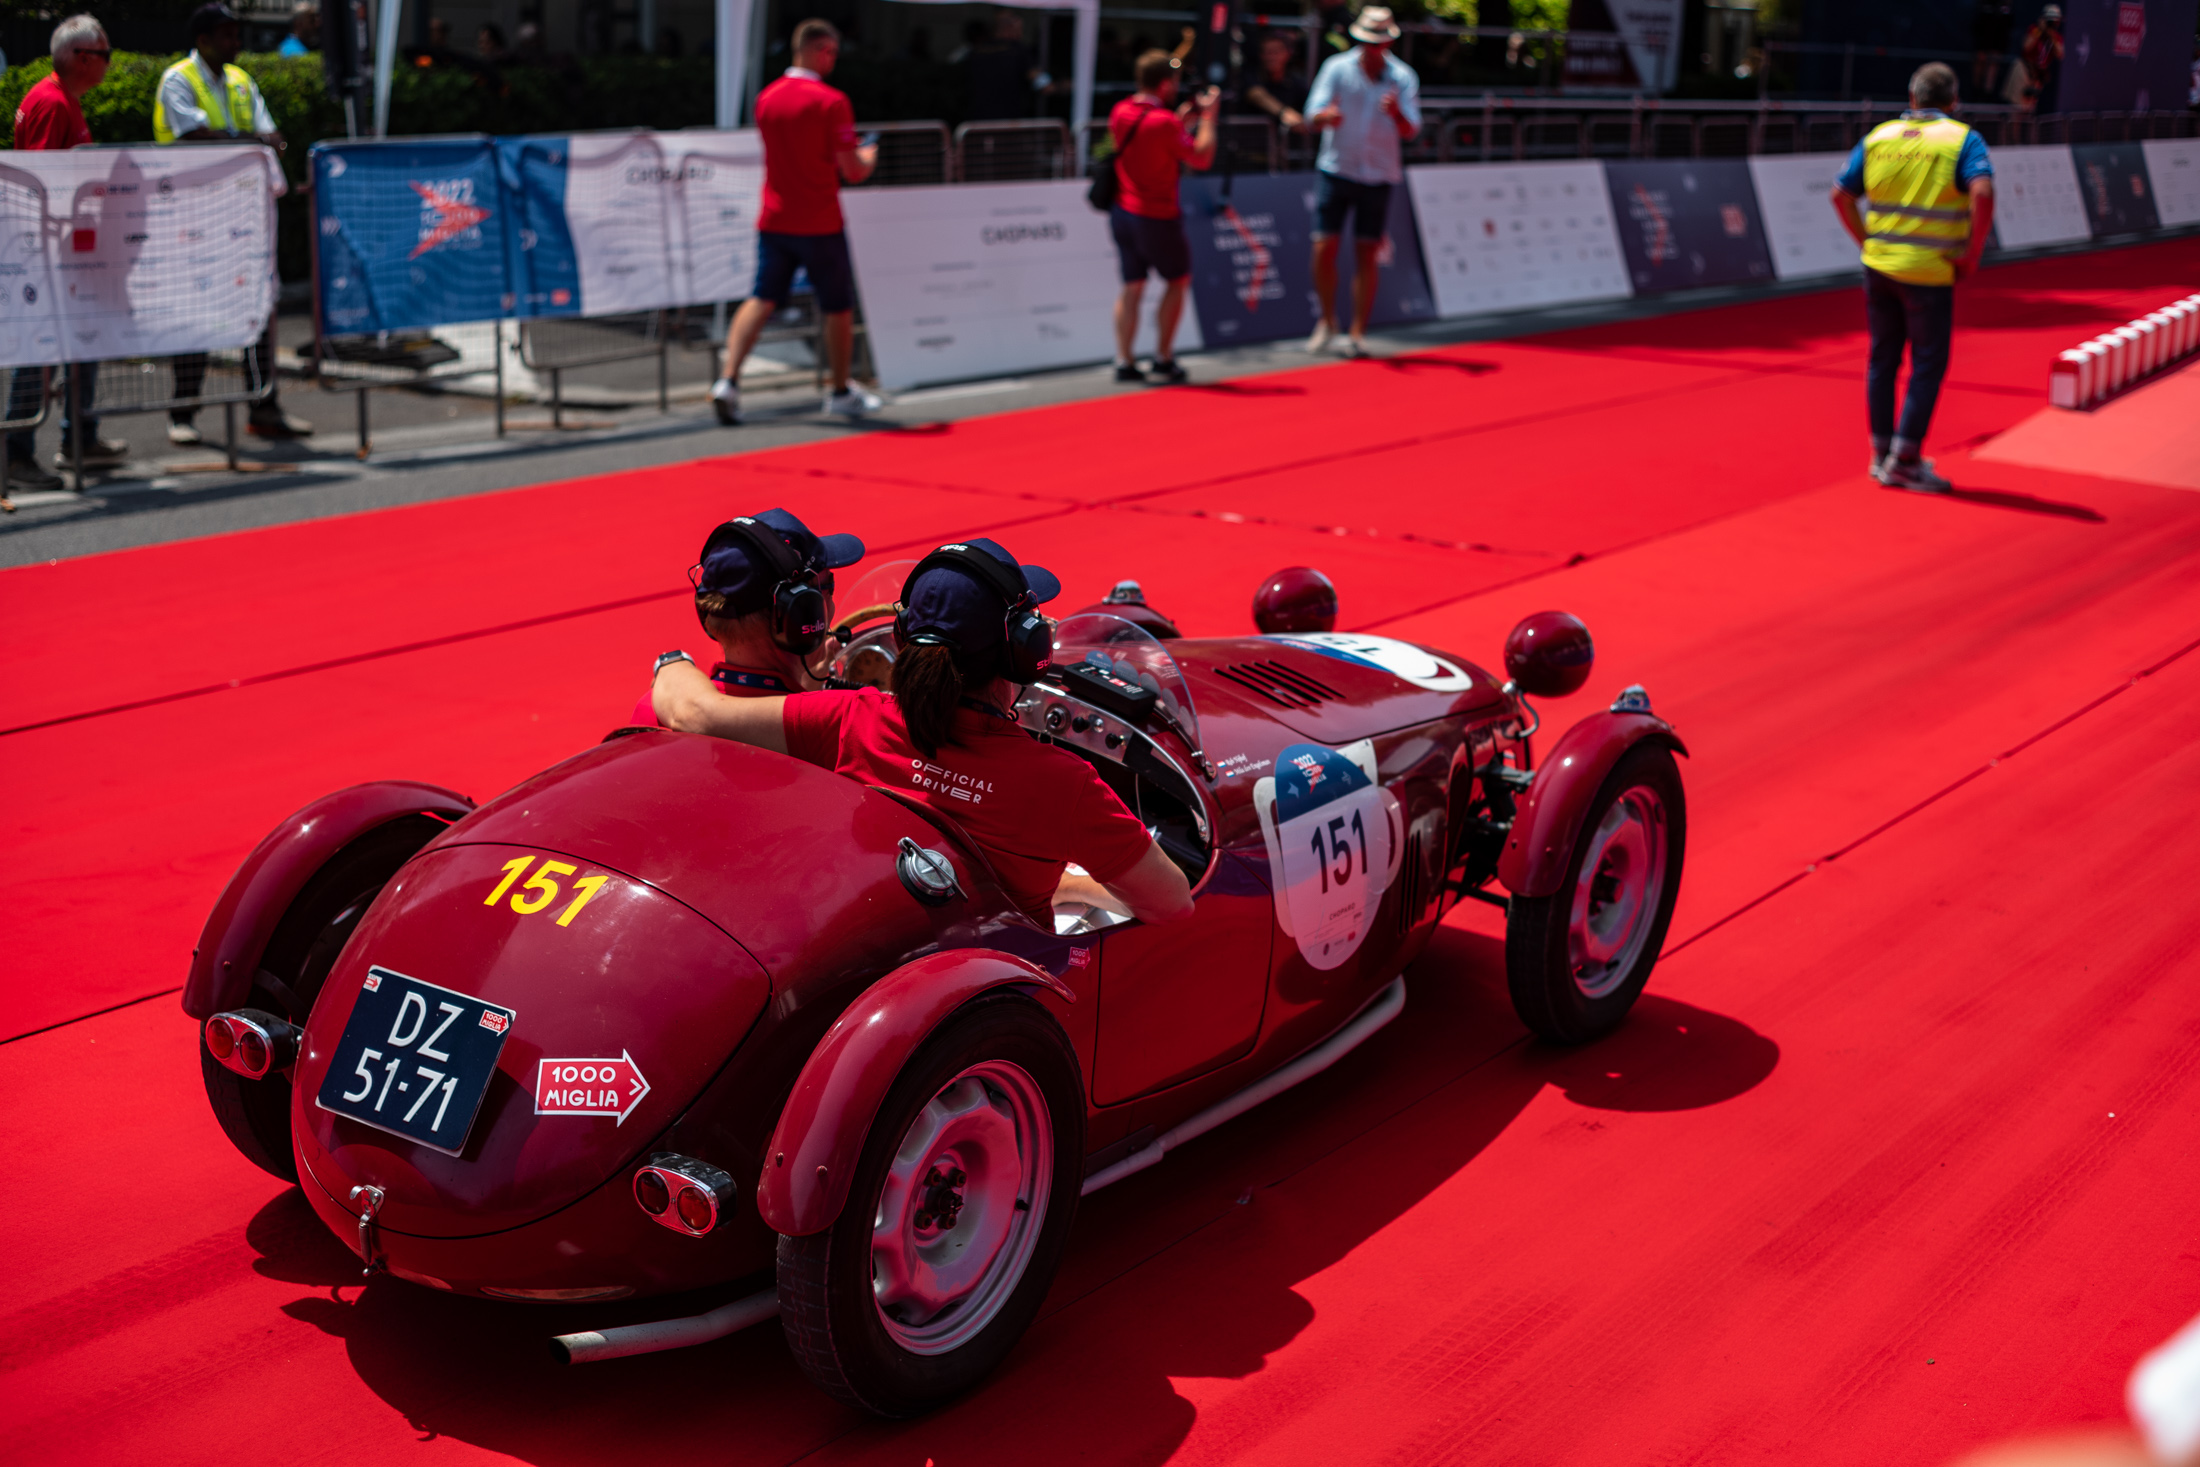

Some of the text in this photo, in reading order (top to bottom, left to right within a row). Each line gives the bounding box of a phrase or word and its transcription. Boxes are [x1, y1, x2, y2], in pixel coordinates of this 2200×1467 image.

[801, 619, 826, 635] Stilo
[1293, 753, 1317, 771] 2022
[911, 759, 994, 793] OFFICIAL
[911, 773, 983, 805] DRIVER
[1310, 808, 1368, 895] 151
[483, 855, 610, 928] 151
[1329, 902, 1356, 921] CHOPARD
[387, 990, 465, 1063] DZ
[481, 1018, 502, 1031] MIGLIA
[486, 1012, 503, 1024] 1000
[551, 1065, 617, 1083] 1000
[544, 1088, 619, 1108] MIGLIA
